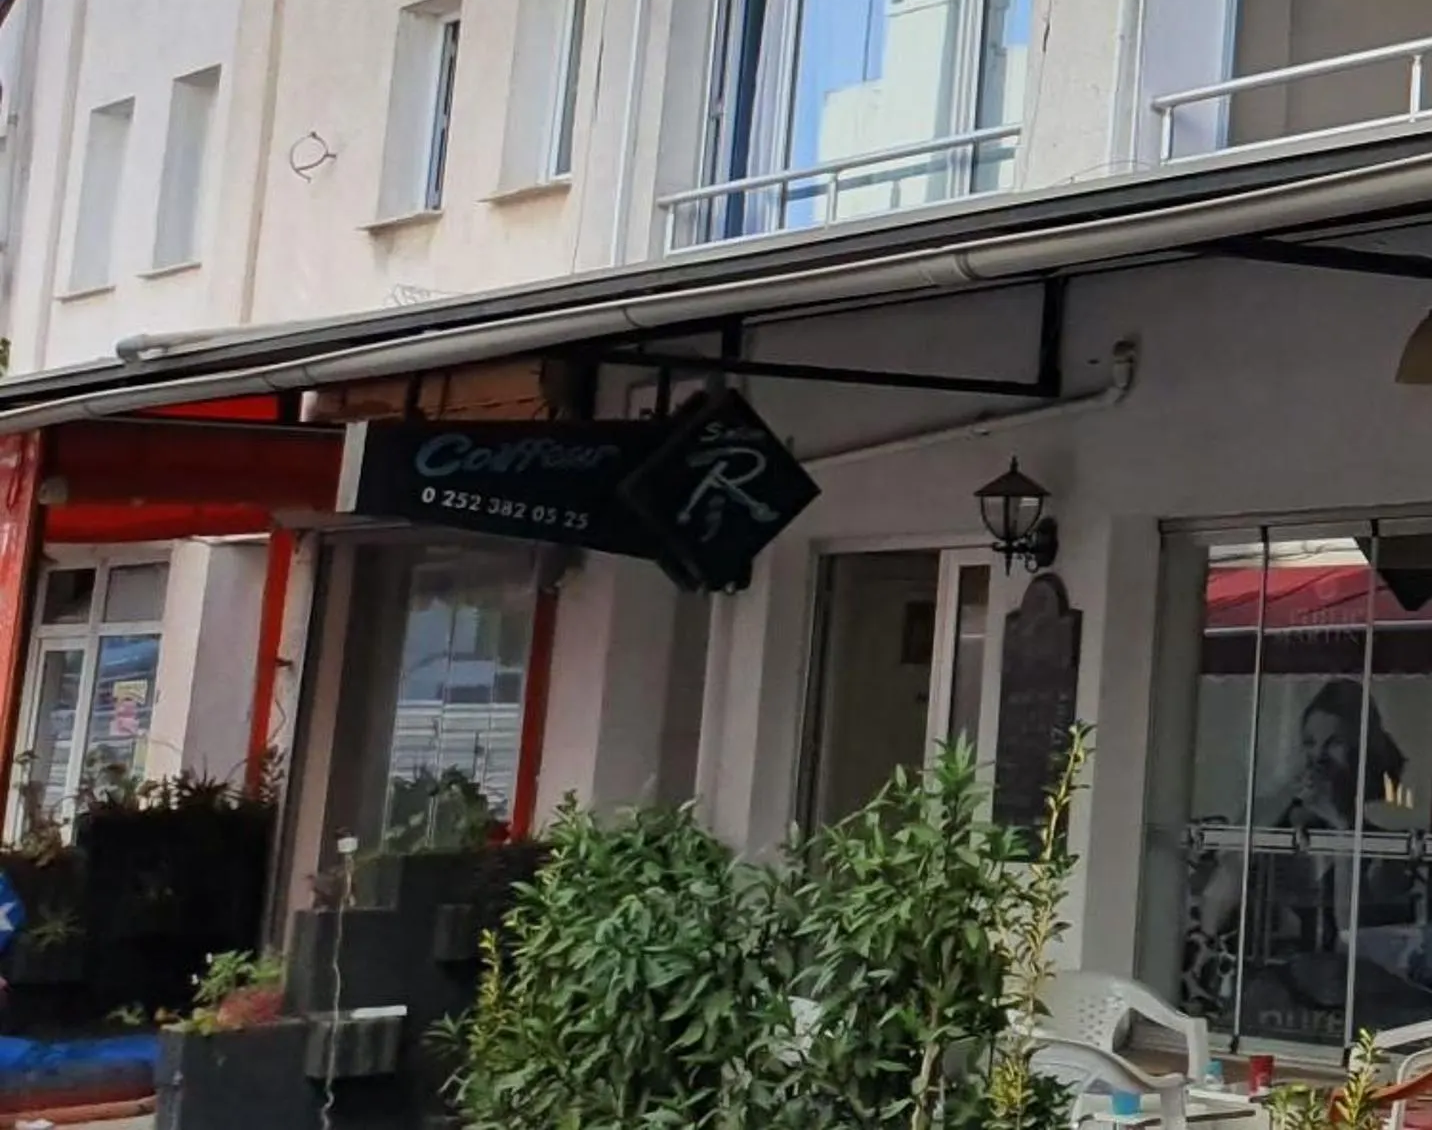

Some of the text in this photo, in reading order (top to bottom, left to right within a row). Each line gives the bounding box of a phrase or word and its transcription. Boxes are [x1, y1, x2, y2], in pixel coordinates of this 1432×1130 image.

[421, 486, 590, 531] 0 252 382 05 25
